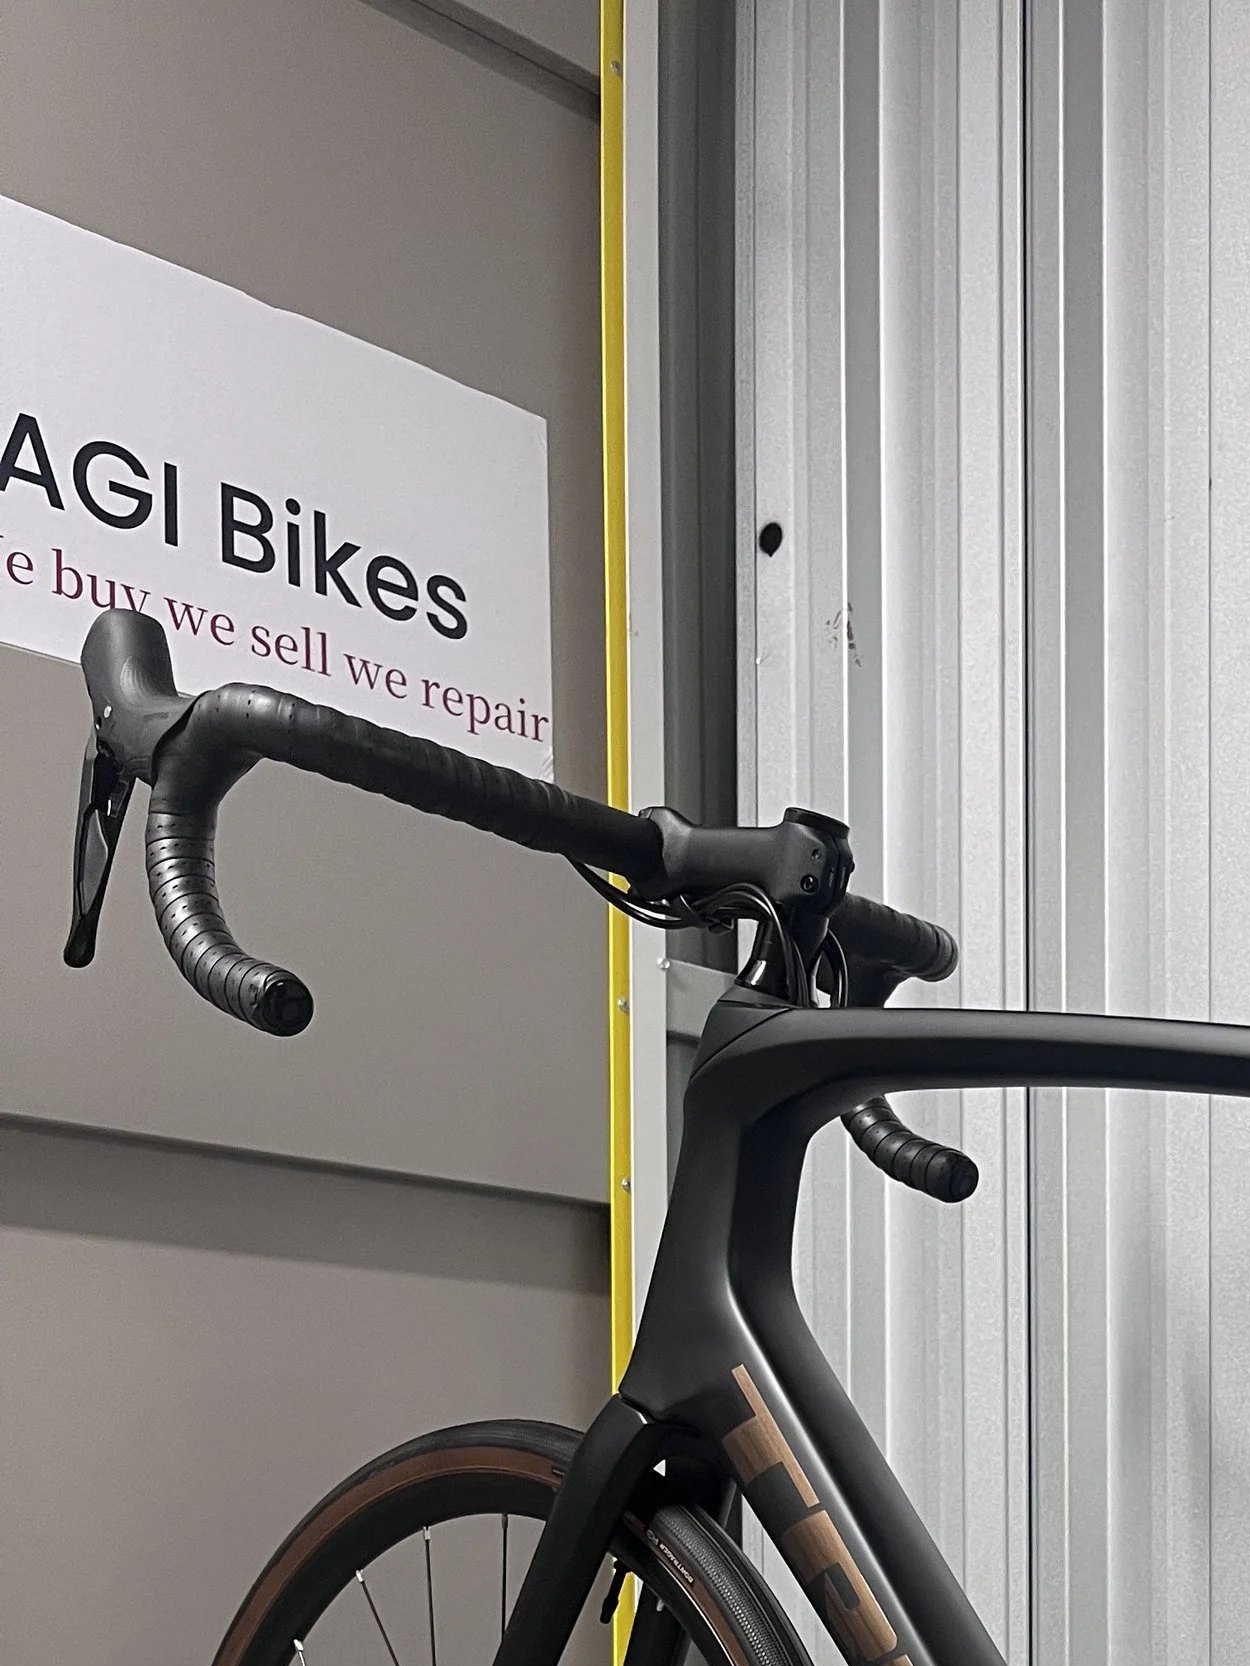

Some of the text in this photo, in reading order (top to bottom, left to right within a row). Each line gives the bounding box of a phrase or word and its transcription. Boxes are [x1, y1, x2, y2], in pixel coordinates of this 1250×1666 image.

[0, 413, 468, 640] AGI Bikes
[0, 534, 34, 585] e
[163, 597, 235, 646] we
[251, 627, 332, 678] sell
[344, 651, 408, 699] we
[421, 678, 549, 743] repair
